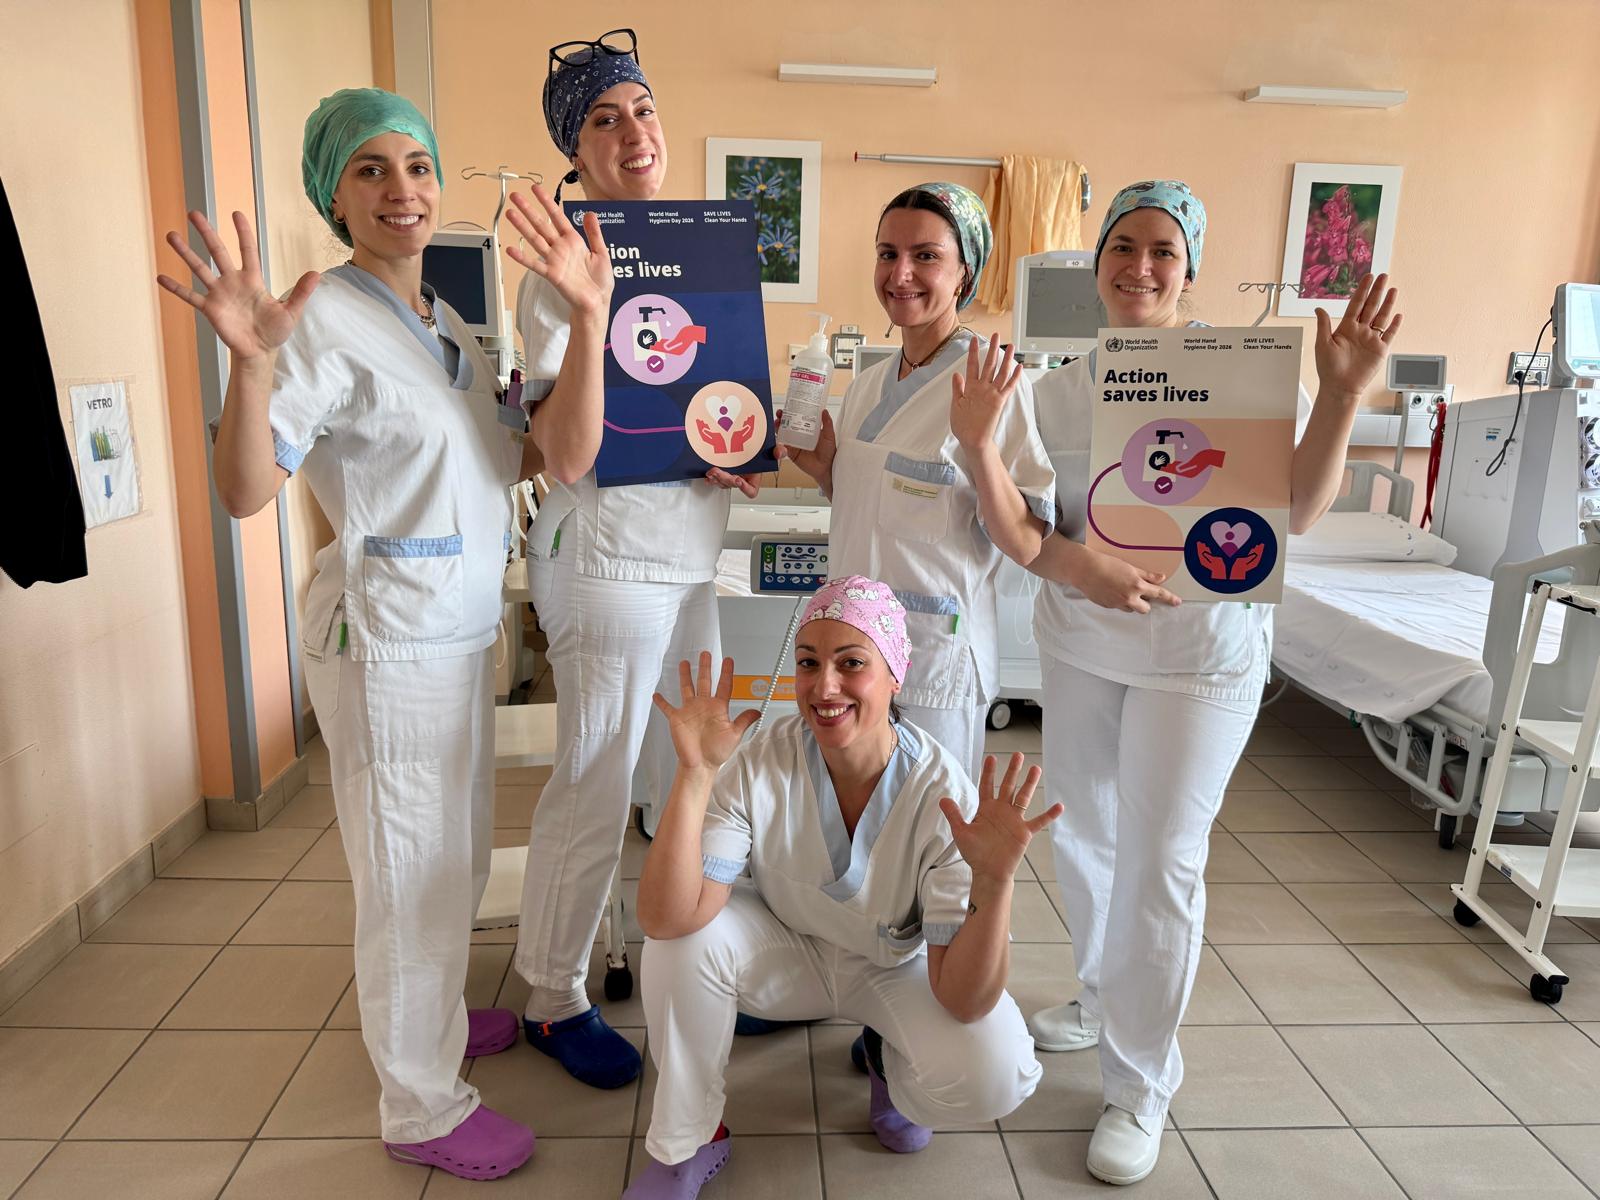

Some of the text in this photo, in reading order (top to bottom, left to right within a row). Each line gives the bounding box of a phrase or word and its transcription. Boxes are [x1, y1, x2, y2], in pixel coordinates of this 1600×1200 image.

[482, 238, 491, 250] 4
[638, 261, 682, 278] lives
[1103, 368, 1168, 384] Action
[1103, 386, 1209, 402] saves lives
[87, 398, 112, 410] VETRO
